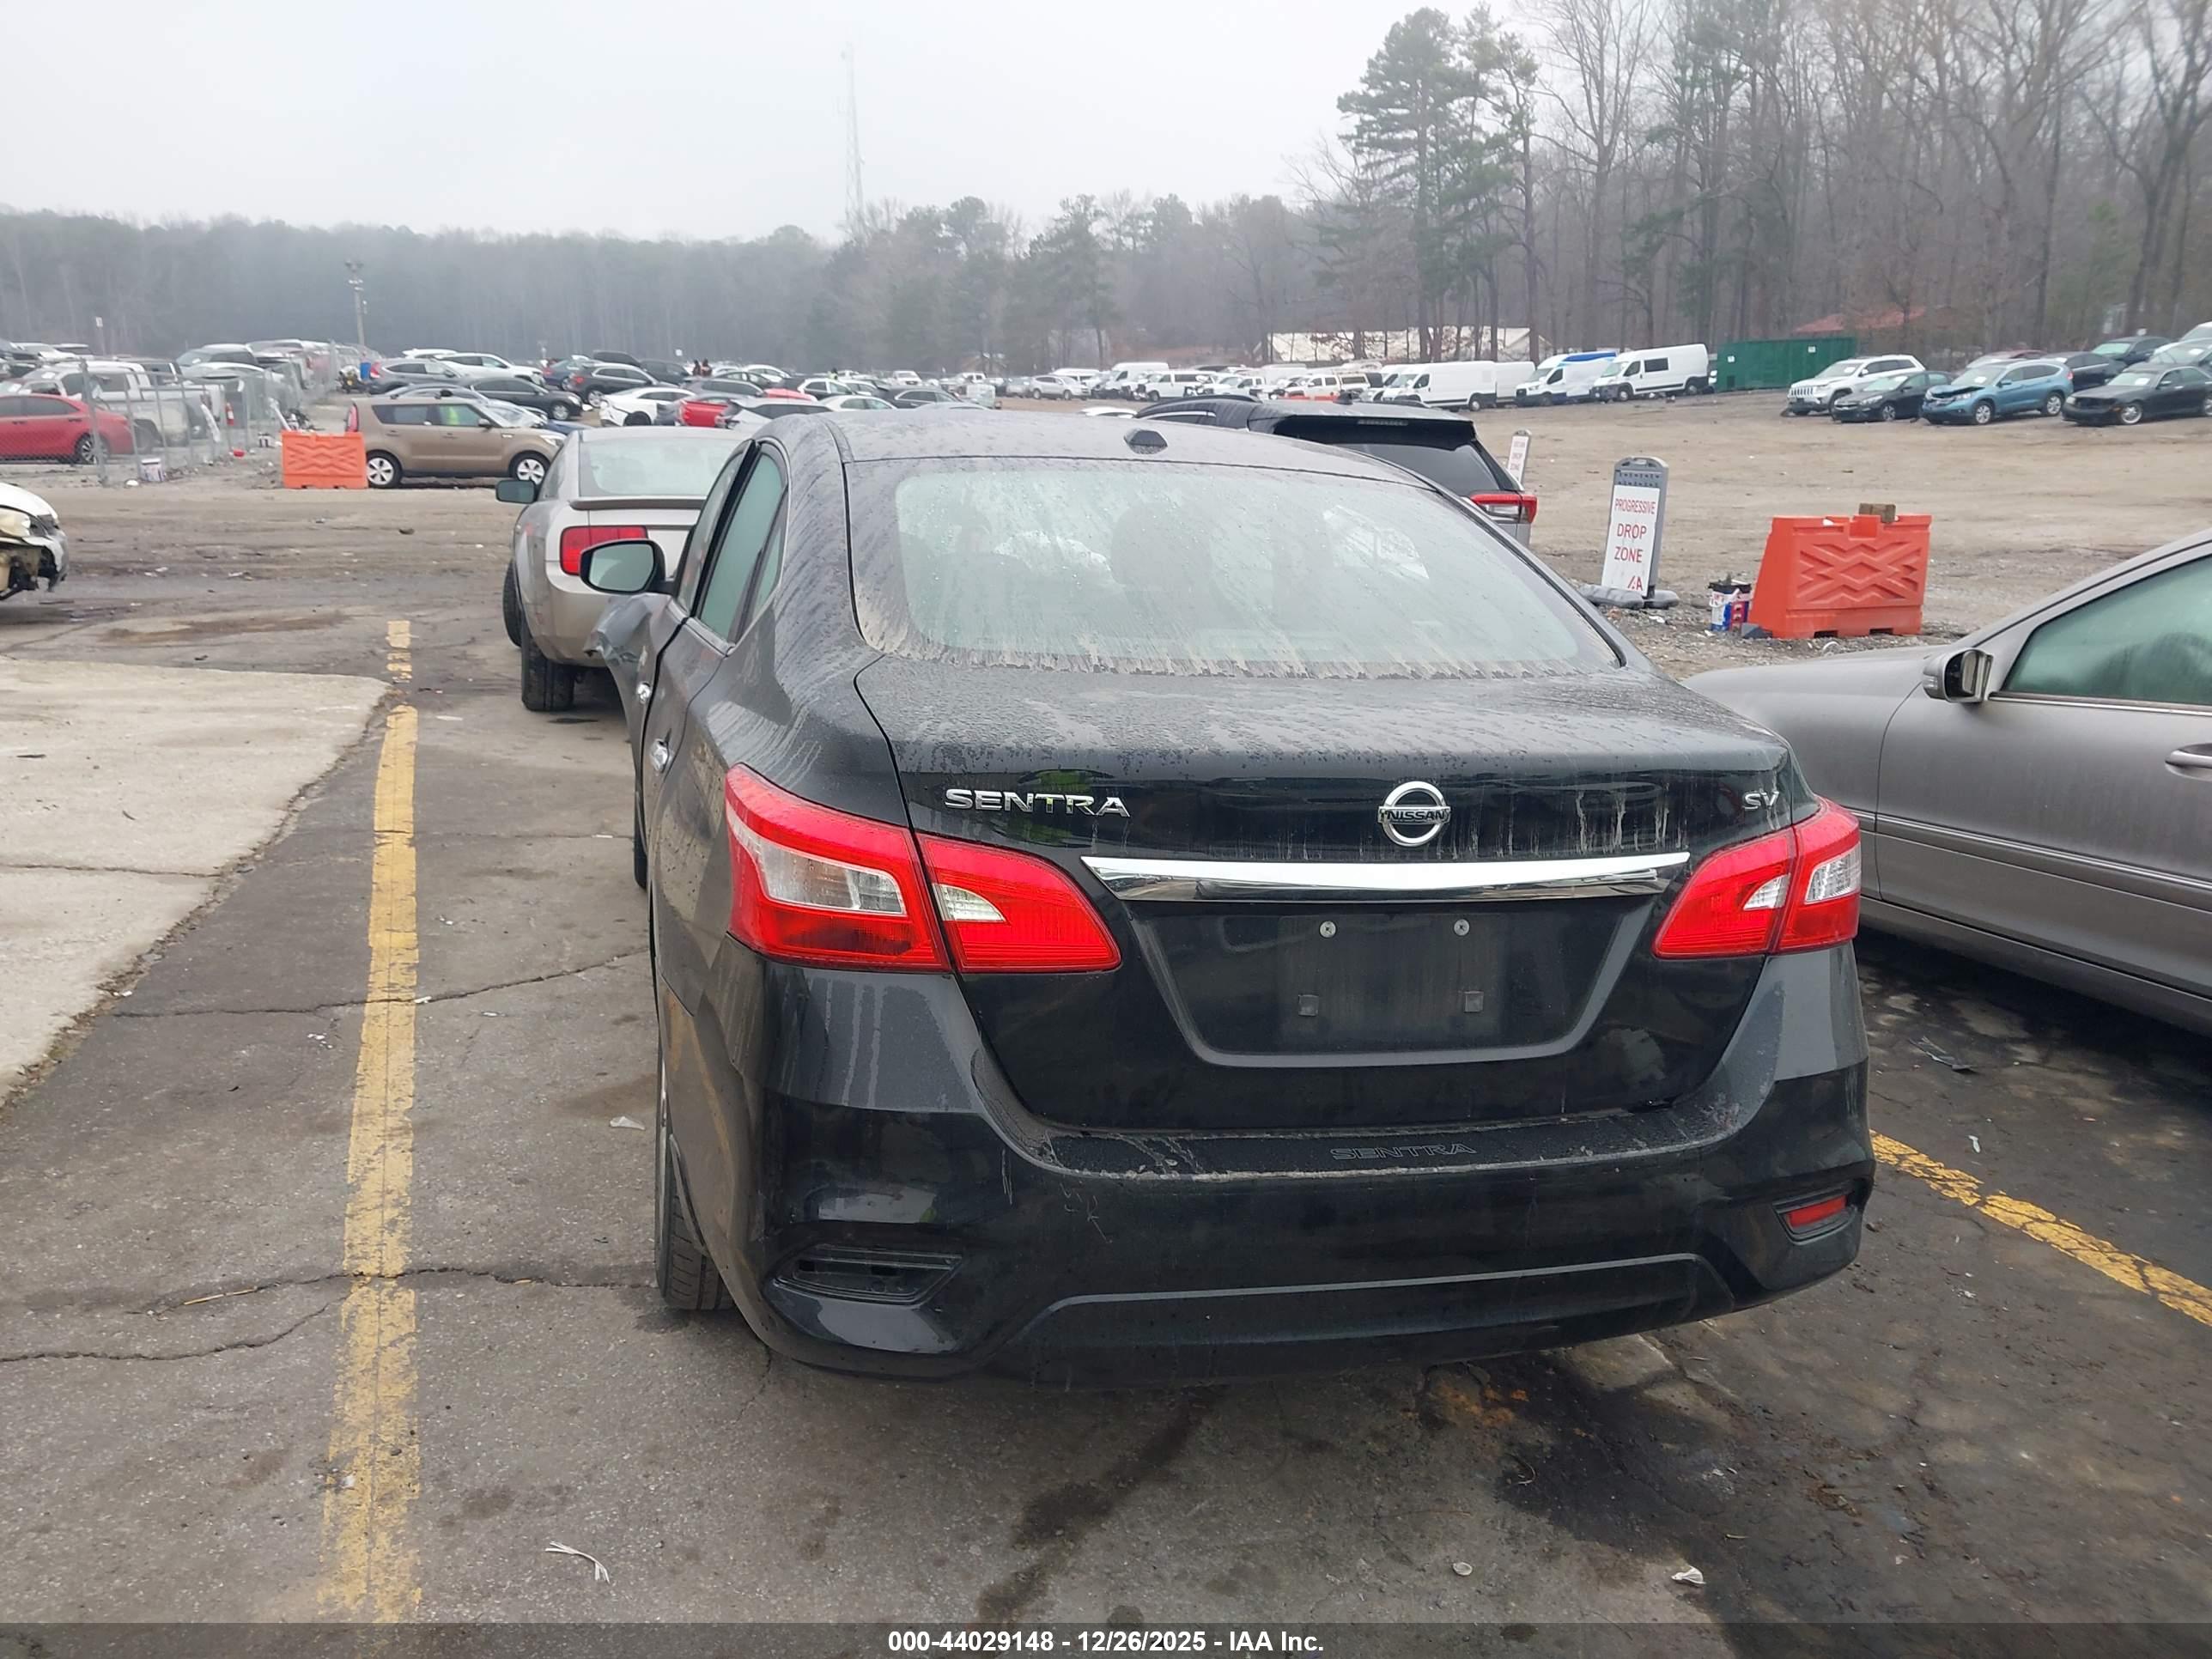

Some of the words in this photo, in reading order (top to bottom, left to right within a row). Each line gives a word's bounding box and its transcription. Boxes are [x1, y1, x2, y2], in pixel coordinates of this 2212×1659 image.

[1614, 498, 1656, 515] PROGRESSIVE
[1617, 523, 1647, 539] DROP
[1614, 546, 1644, 563] ZONE
[945, 787, 1131, 818] SENTRA
[1744, 790, 1780, 811] SV
[1387, 810, 1445, 821] NISSAN
[1329, 1143, 1478, 1161] SENTRA
